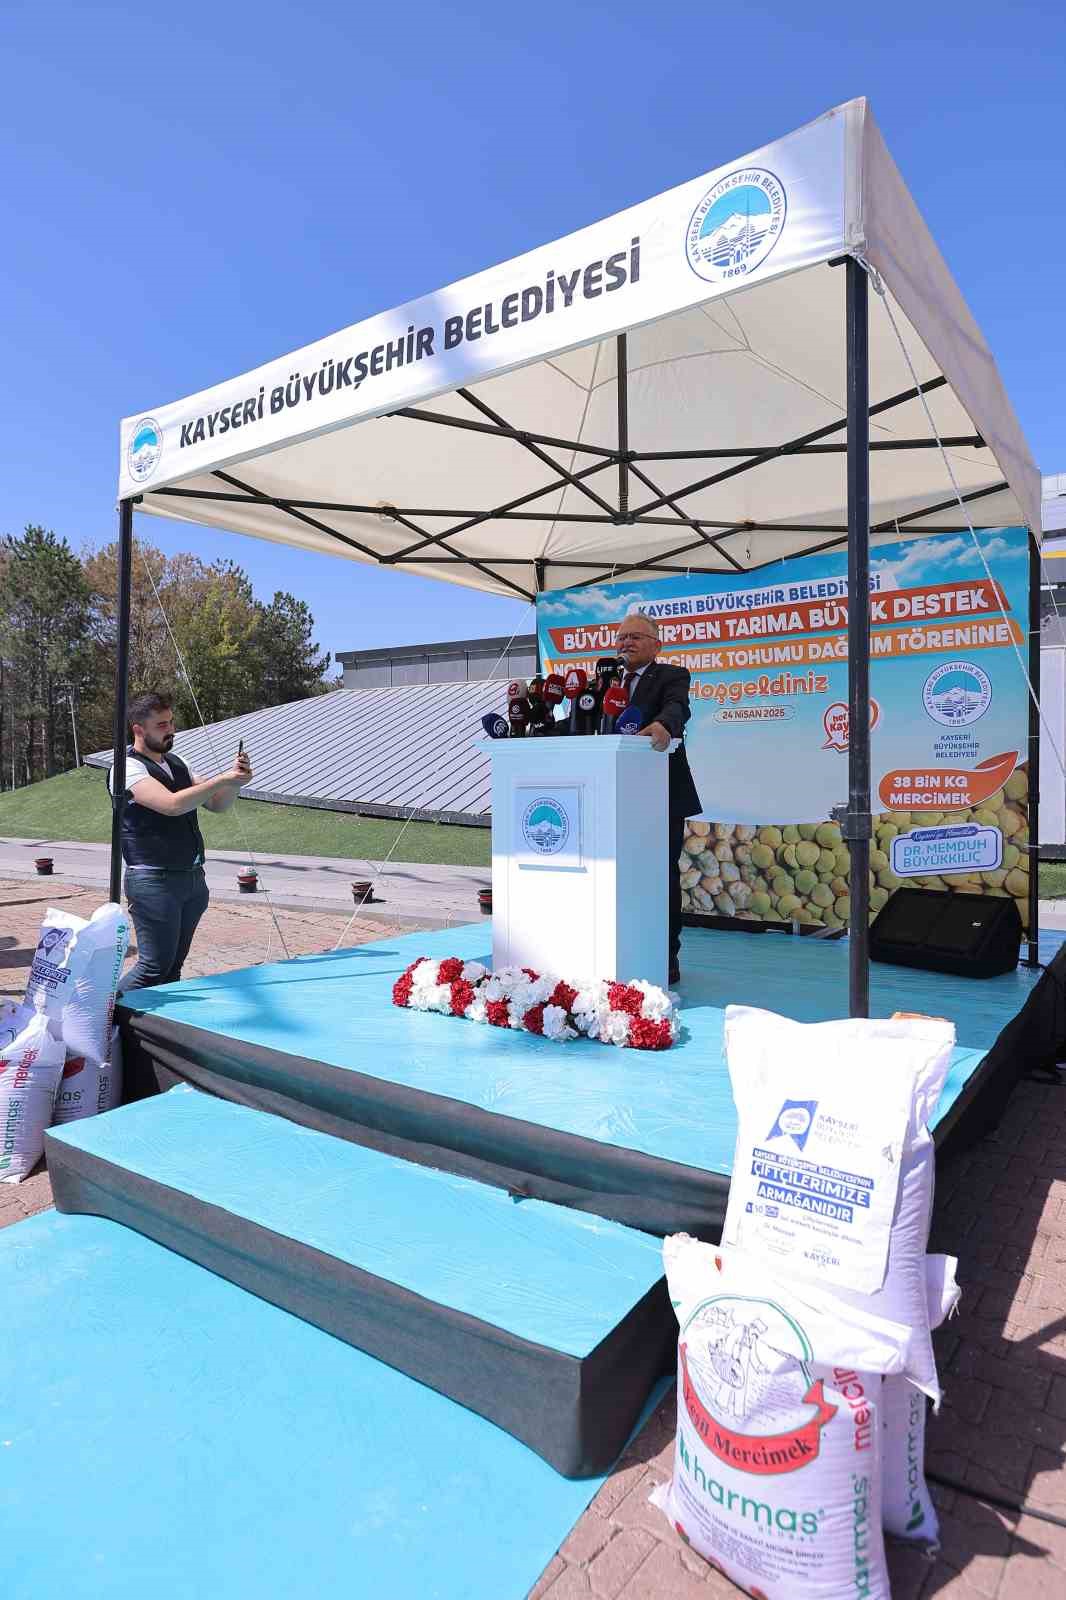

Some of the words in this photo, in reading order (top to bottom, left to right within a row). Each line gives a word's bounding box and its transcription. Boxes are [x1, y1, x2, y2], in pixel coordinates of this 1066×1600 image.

[722, 263, 747, 279] 1869
[180, 387, 265, 448] KAYSERİ
[270, 326, 435, 416] BÜYÜKŞEHİR
[444, 236, 641, 351] BELEDİYESİ
[638, 600, 693, 617] KAYSERİ
[696, 588, 785, 613] BÜYÜKŞEHİR
[789, 575, 881, 601] BELEDİSİ
[725, 610, 805, 638] TARIMA
[808, 600, 888, 628] BÜYK
[893, 588, 989, 618] DESTEK
[726, 644, 804, 664] TOHUMU
[808, 636, 892, 659] DAĞIM
[897, 623, 1010, 650] TÖRENİNE
[690, 672, 829, 704] Hoşgeldiniz
[722, 711, 733, 720] 24
[889, 792, 972, 805] MERCİMEK
[894, 776, 912, 788] 38
[914, 775, 941, 788] BİN
[944, 775, 969, 788] KG
[903, 850, 982, 868] BÜYÜKKILIÇ
[927, 839, 987, 854] MEMDUH
[753, 1161, 868, 1206] ÇİFTÇİLERİMİZE
[759, 1183, 852, 1222] ARMAĞANIDIR
[713, 1431, 813, 1467] Mercimek
[693, 1454, 819, 1536] harmas
